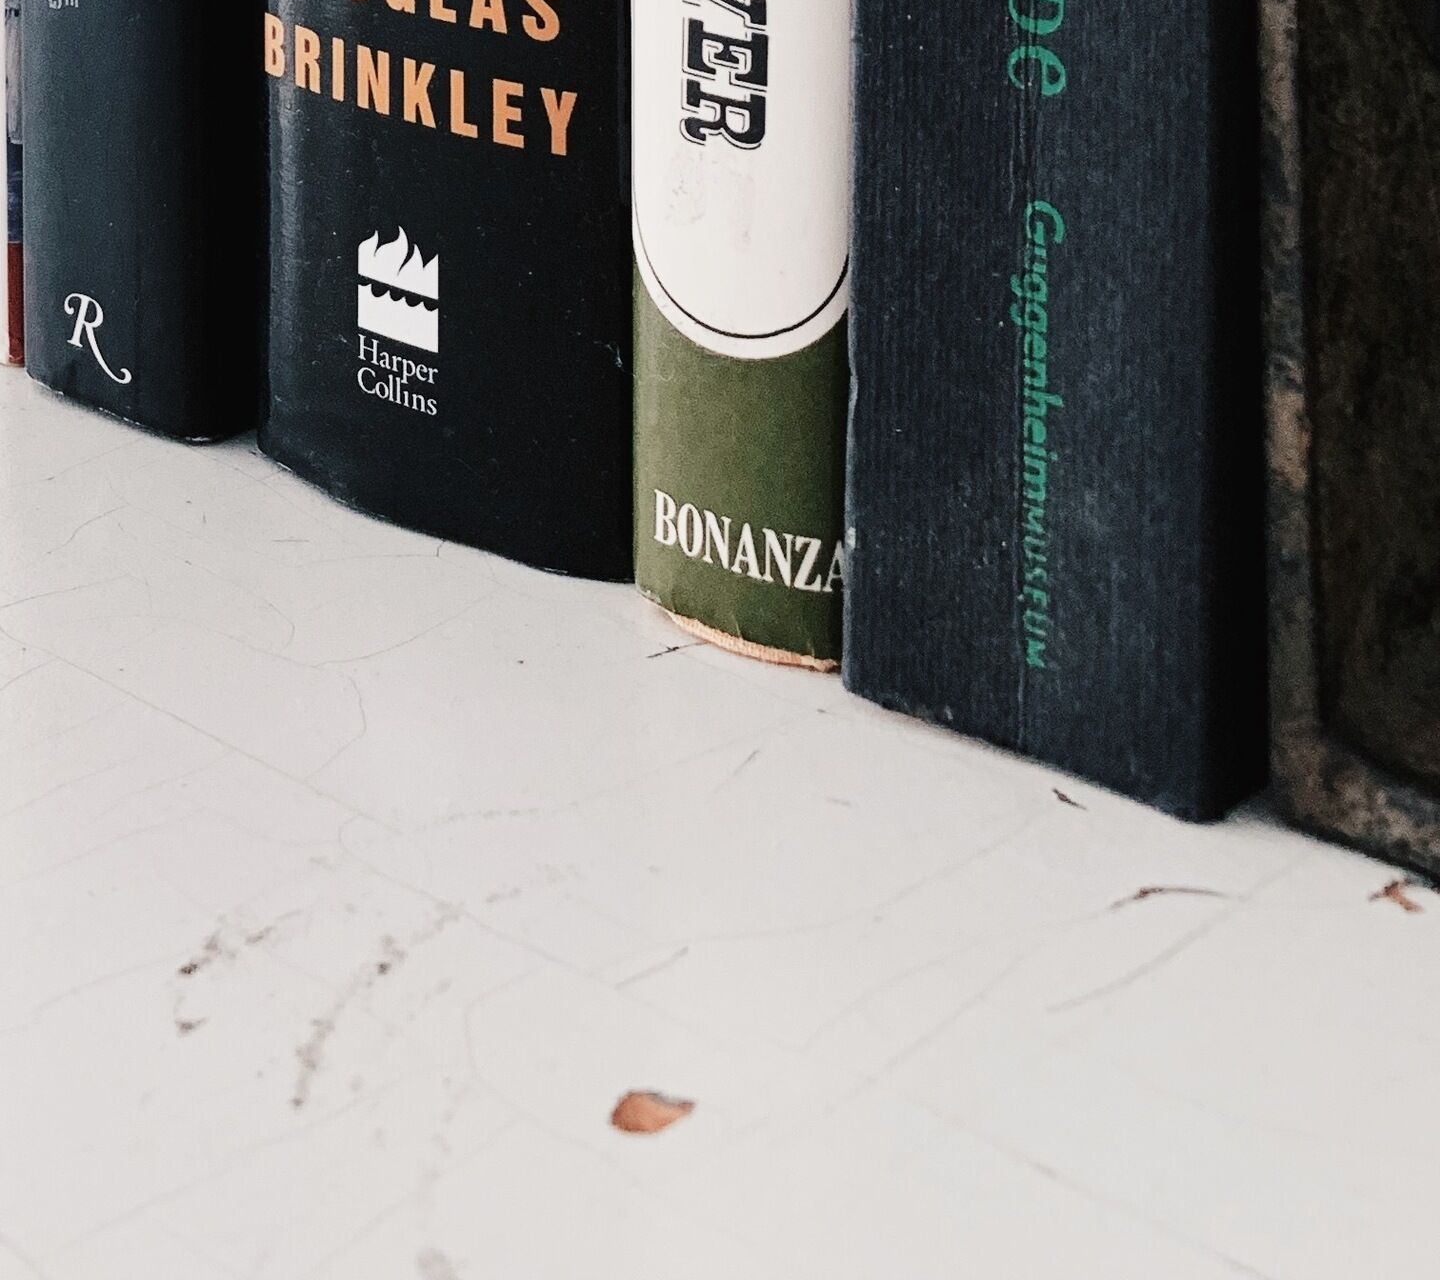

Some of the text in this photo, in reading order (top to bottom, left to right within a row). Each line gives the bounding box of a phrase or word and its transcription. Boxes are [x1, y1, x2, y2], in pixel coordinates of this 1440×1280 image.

[264, 11, 578, 157] BRINKLEY
[63, 292, 132, 384] R
[357, 333, 439, 385] Harper
[357, 366, 438, 416] Collins
[653, 488, 847, 592] BONANZA
